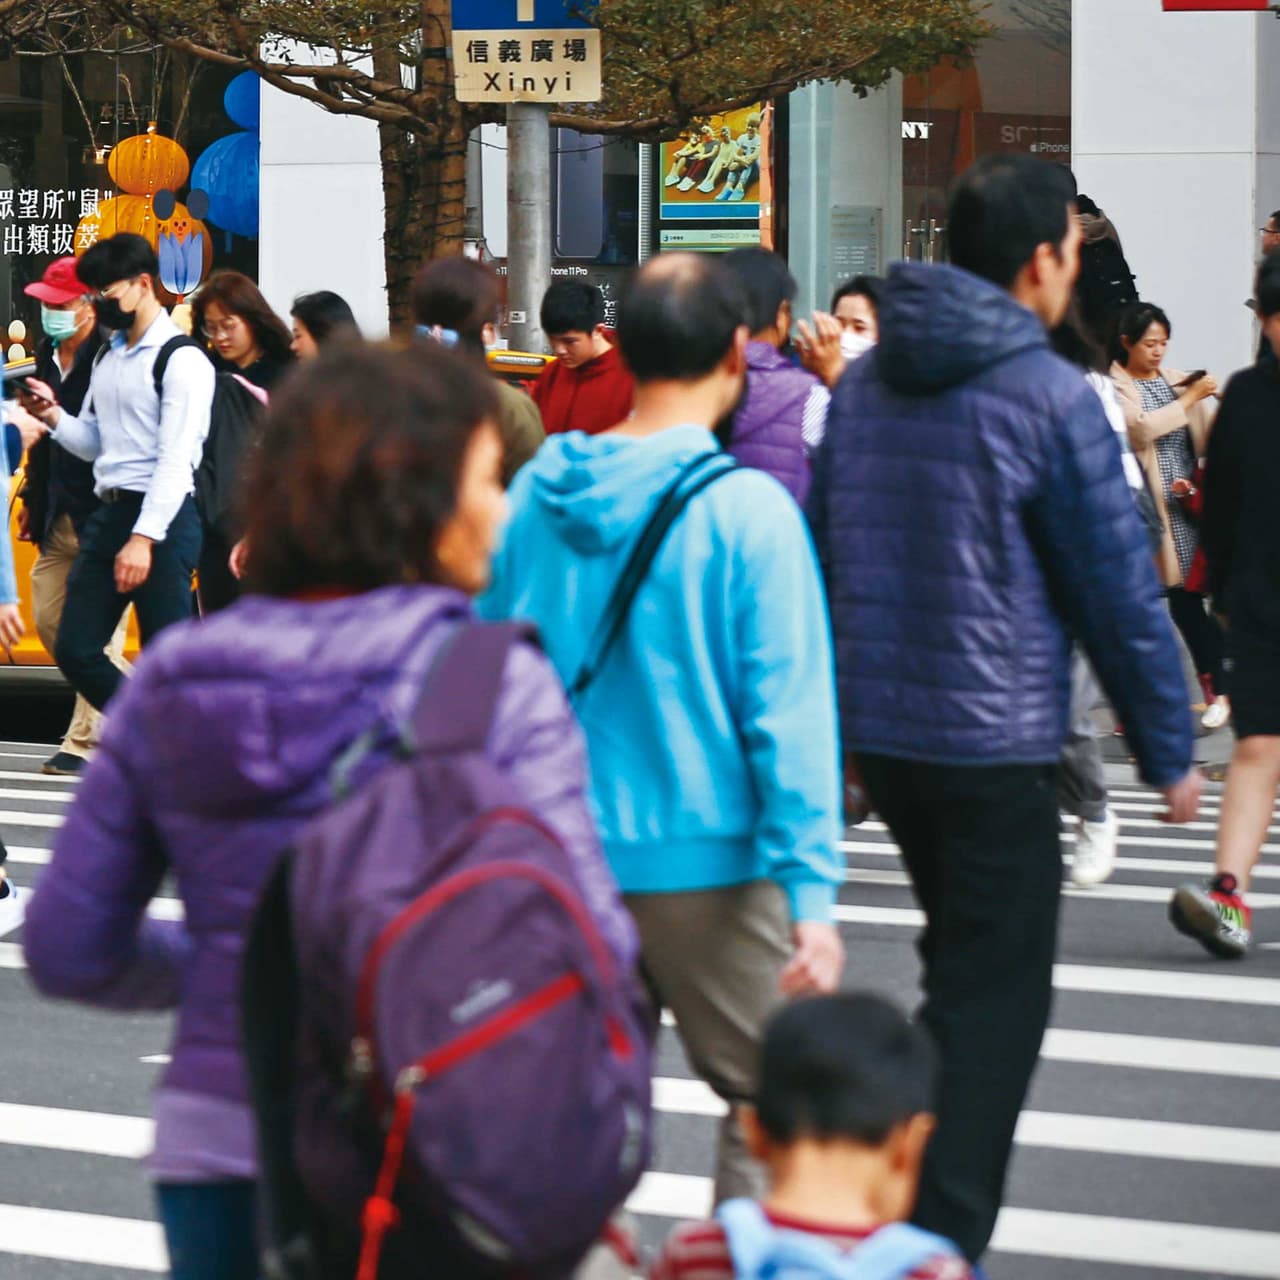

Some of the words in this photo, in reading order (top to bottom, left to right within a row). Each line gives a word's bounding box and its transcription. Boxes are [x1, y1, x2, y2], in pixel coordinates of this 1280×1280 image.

[466, 38, 587, 64] 信義廣場
[483, 71, 572, 95] Xinyi
